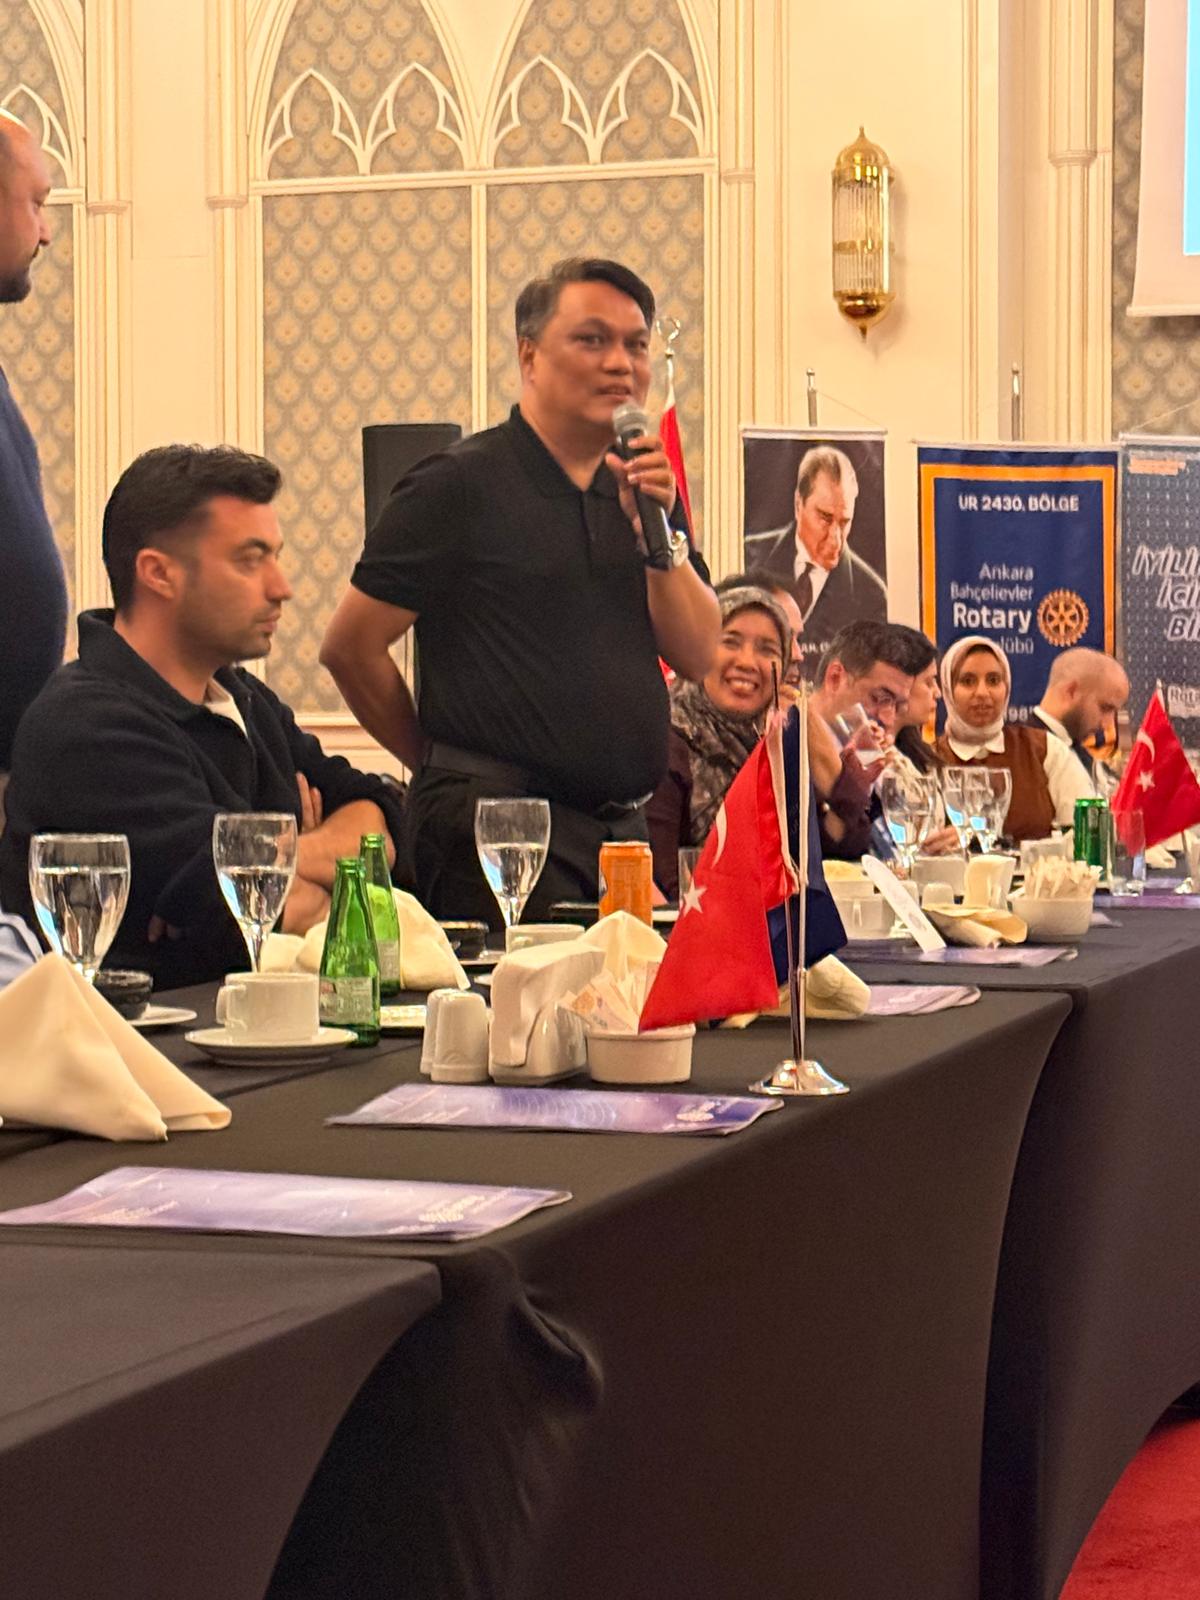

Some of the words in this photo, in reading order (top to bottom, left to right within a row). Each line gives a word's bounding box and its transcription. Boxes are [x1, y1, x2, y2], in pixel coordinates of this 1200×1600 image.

[981, 494, 1026, 511] 2430.
[1028, 491, 1079, 512] BÖLGE
[979, 562, 1034, 581] Ankara
[950, 581, 1033, 605] Bahçelievler
[953, 602, 1032, 634] Rotary
[1000, 635, 1034, 654] lübü
